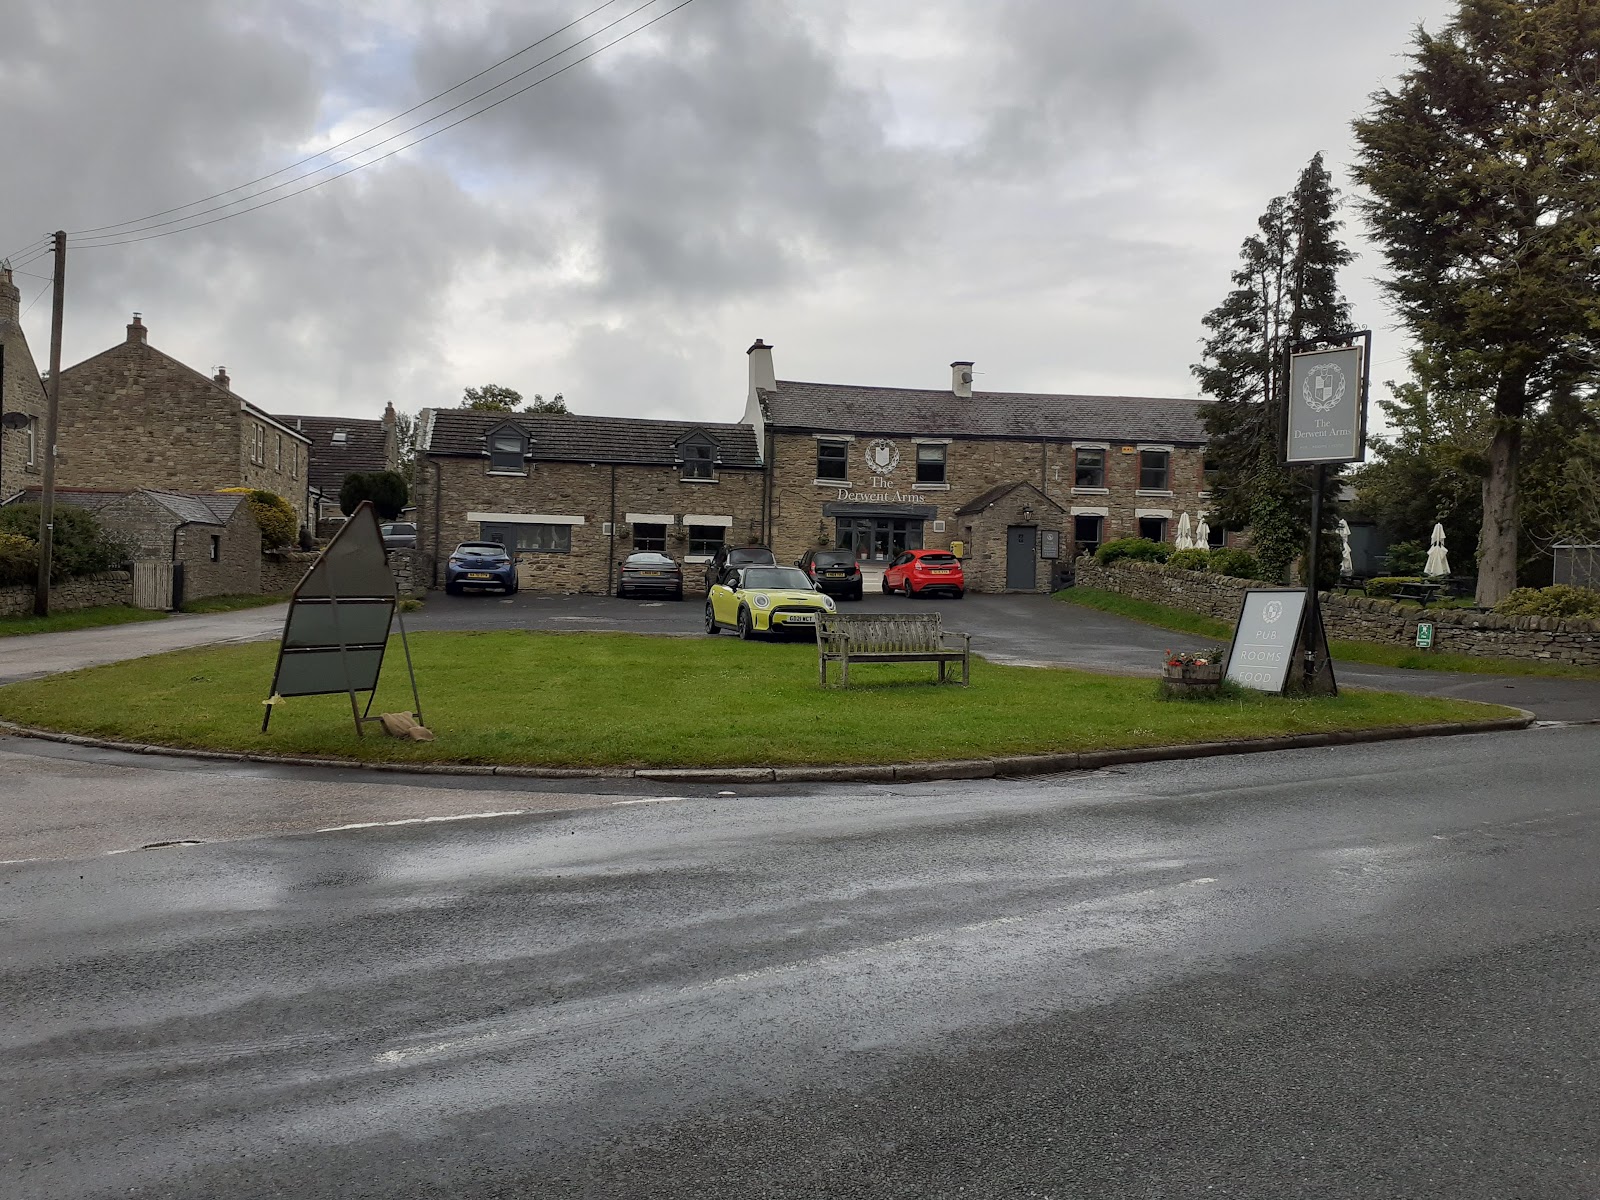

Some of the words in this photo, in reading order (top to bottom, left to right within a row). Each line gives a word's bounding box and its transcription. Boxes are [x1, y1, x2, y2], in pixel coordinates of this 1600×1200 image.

[1314, 419, 1331, 428] The
[1294, 430, 1327, 439] Derwent
[1329, 428, 1352, 437] Arms
[869, 476, 894, 488] The
[837, 489, 889, 502] Derwent
[892, 490, 925, 502] Arms
[1255, 630, 1277, 640] PUB
[1240, 650, 1281, 661] ROOMS
[1238, 671, 1271, 683] FOOD
